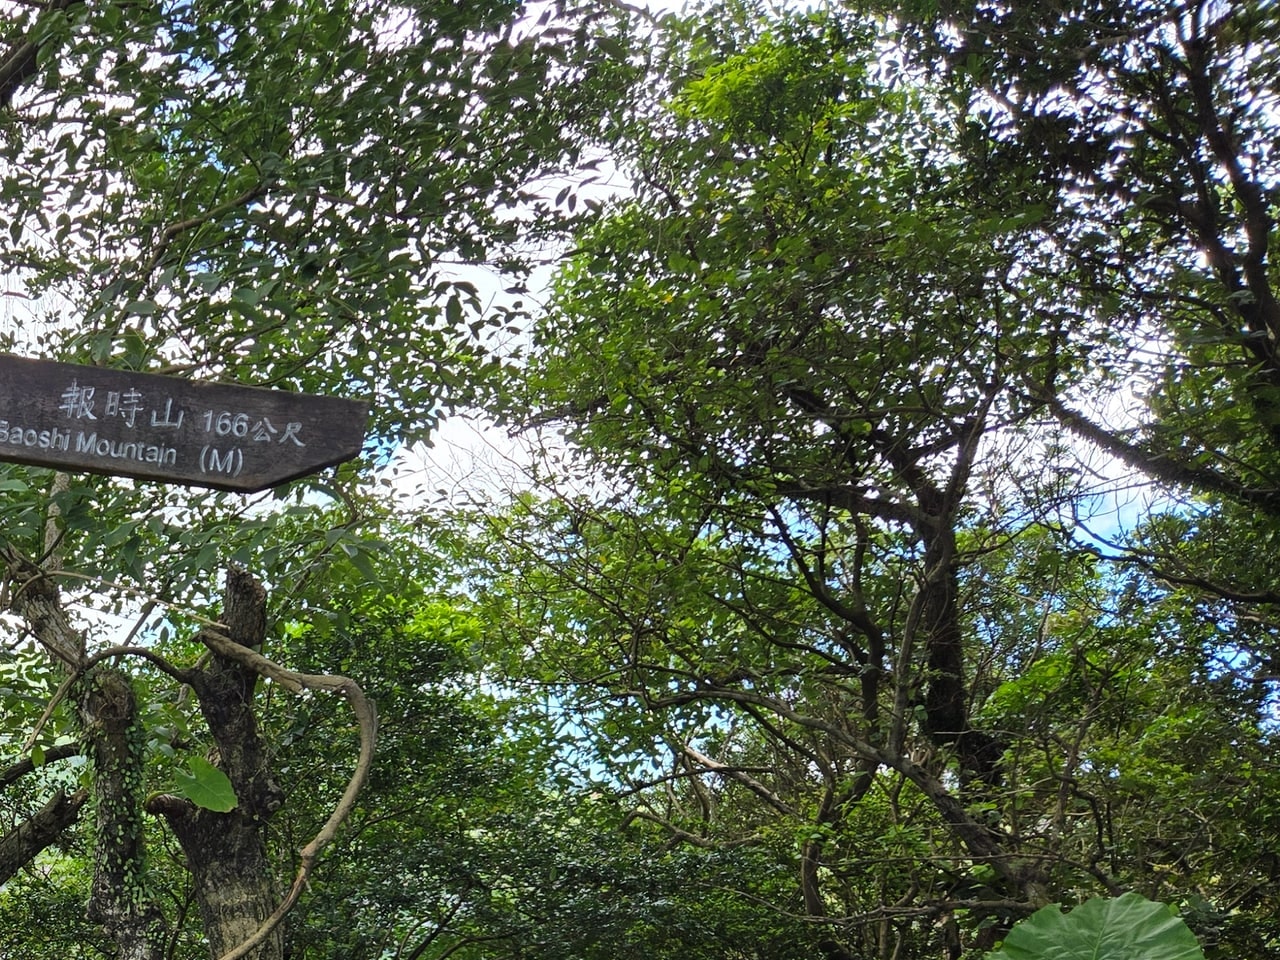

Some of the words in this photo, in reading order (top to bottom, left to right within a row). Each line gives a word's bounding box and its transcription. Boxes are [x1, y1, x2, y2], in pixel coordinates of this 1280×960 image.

[57, 377, 187, 432] 報時山
[202, 408, 308, 448] 166公尺
[75, 431, 178, 468] Mountain
[199, 445, 245, 478] (M)
